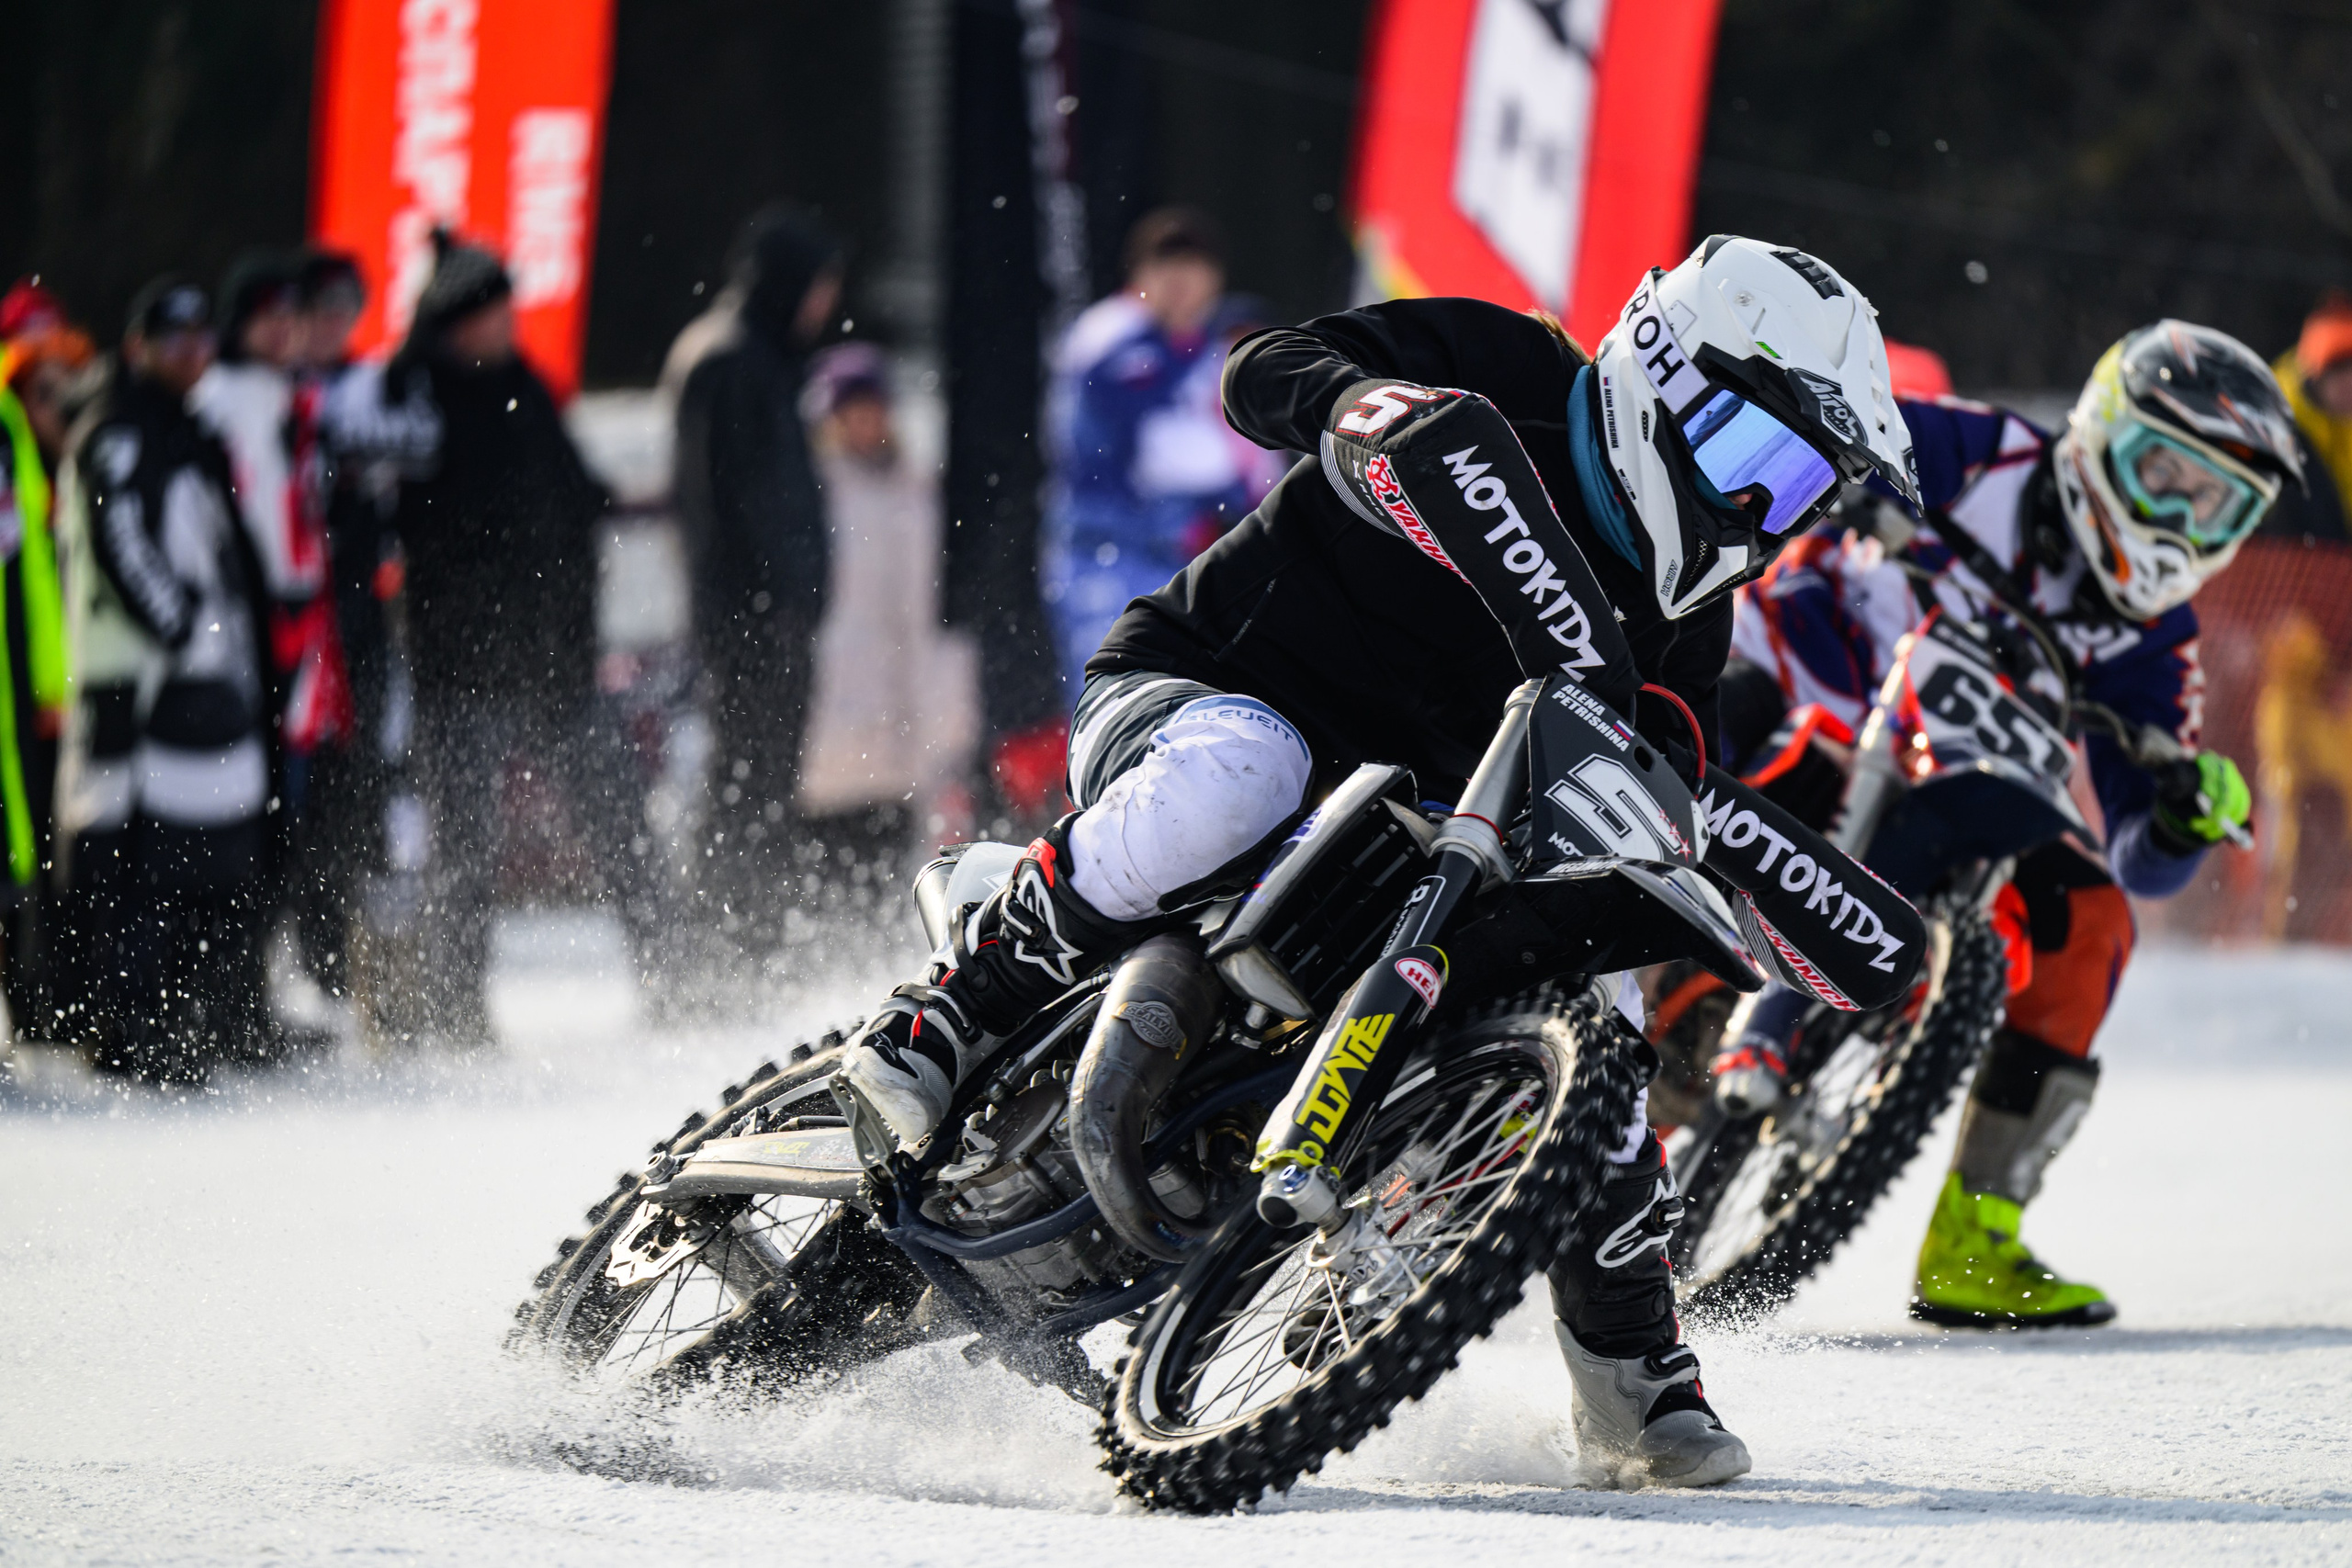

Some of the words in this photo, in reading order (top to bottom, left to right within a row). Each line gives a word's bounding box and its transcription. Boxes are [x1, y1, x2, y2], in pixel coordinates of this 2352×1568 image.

[1442, 445, 1607, 683] MOTOKIDZ
[1659, 558, 1679, 597] AIROH
[1551, 690, 1631, 752] PETRISHINA
[1561, 683, 1606, 716] ALENA
[1544, 752, 1681, 862] 5
[1699, 787, 1906, 974] MOTOKIDZ
